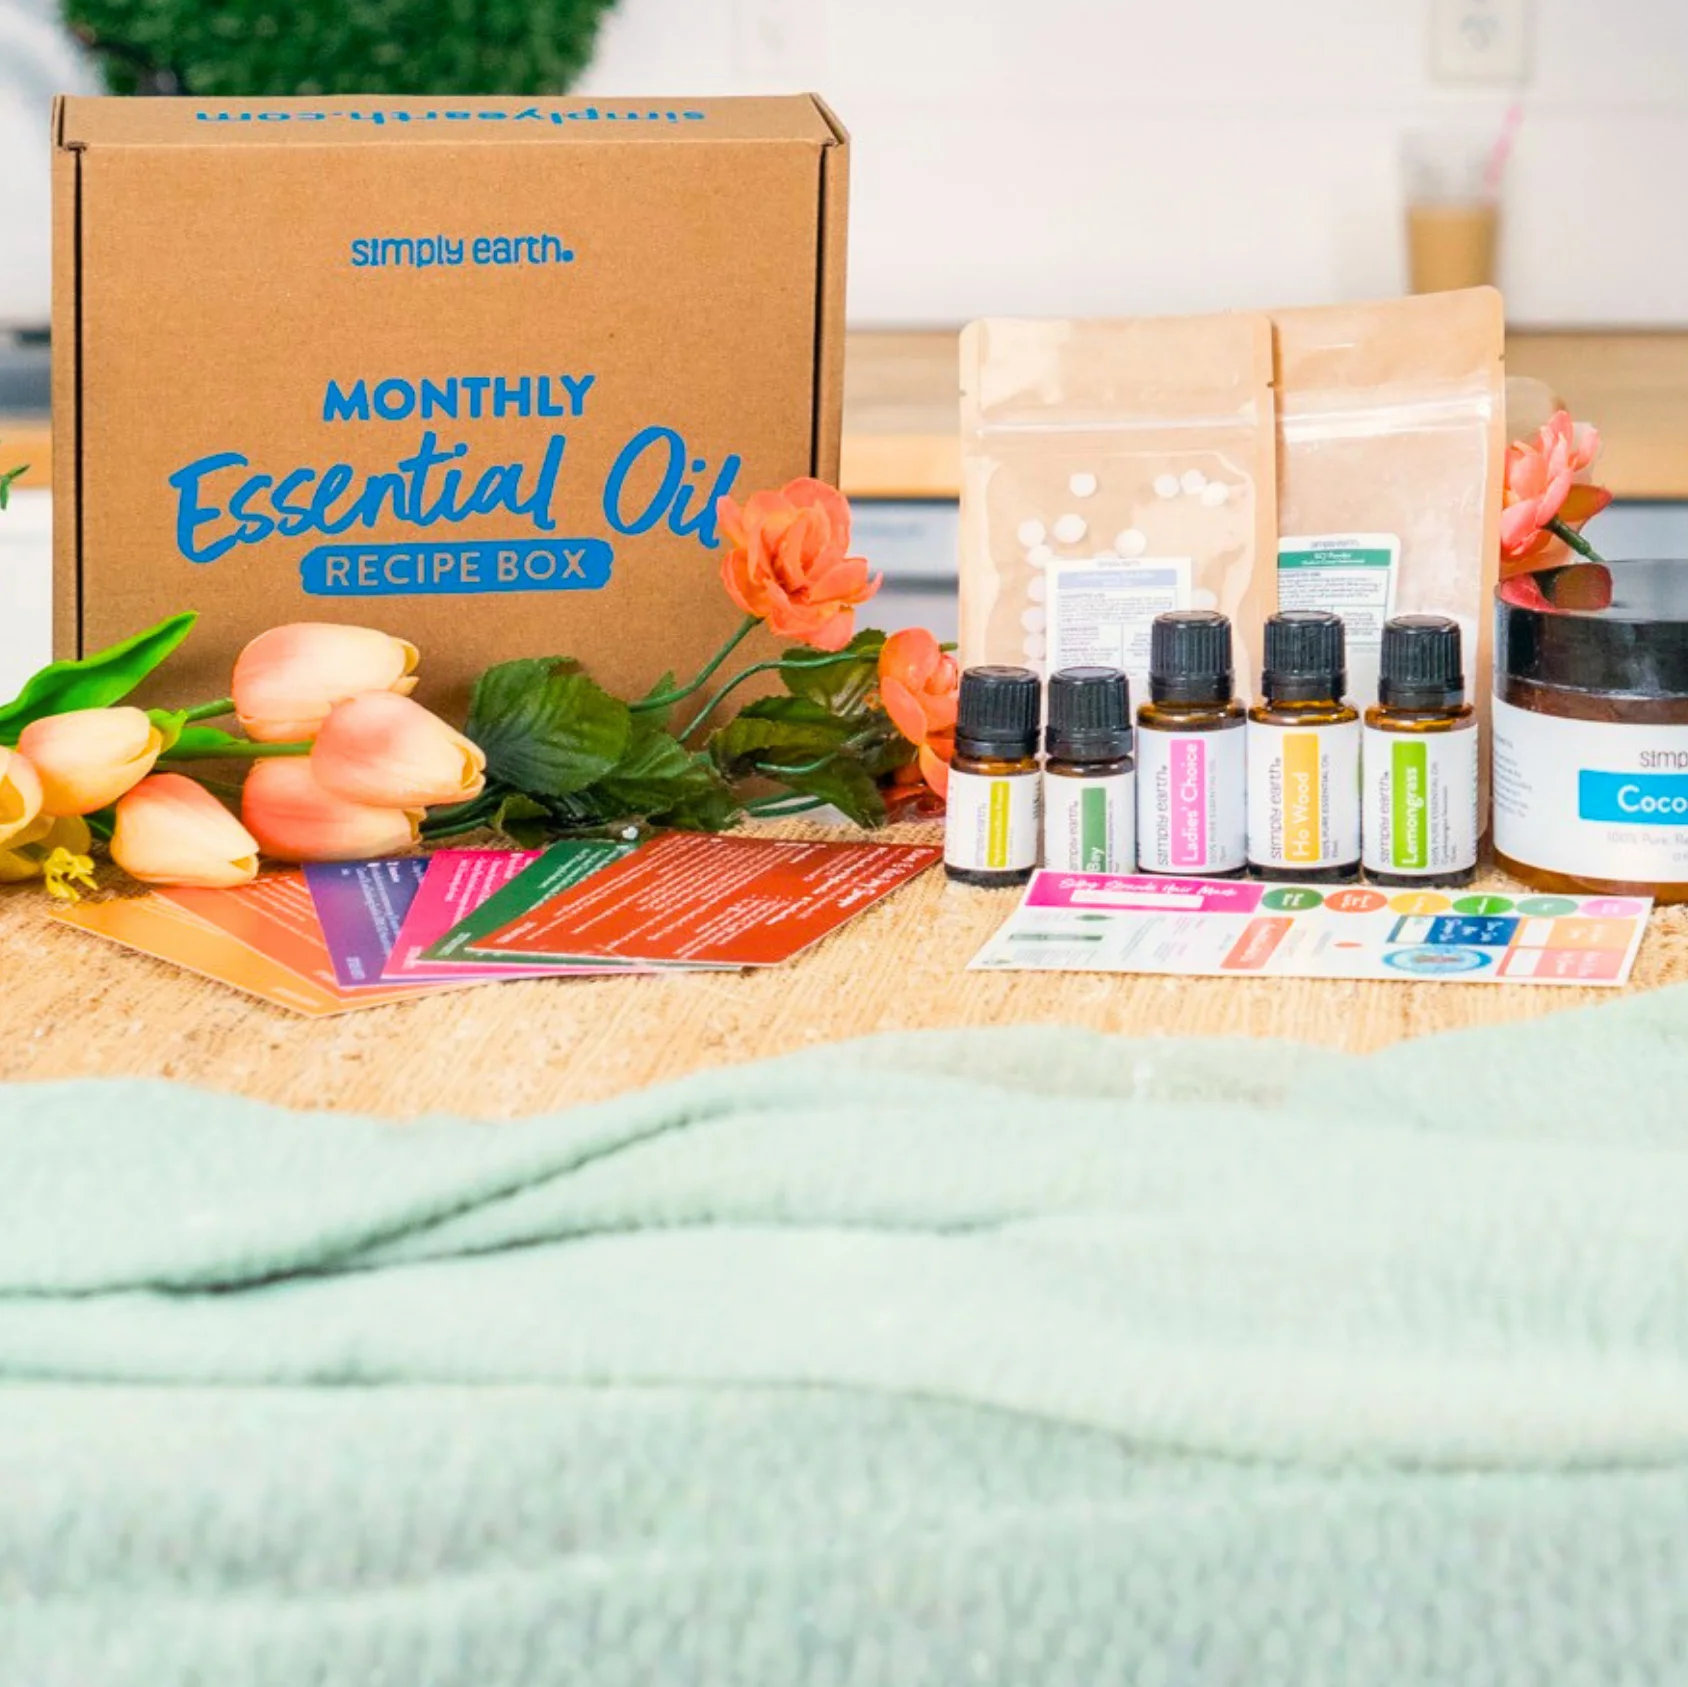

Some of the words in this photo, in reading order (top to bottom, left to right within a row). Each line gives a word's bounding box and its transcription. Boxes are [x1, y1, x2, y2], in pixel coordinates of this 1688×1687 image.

[196, 107, 705, 124] simplyearth.com
[350, 234, 464, 269] simply
[322, 374, 596, 422] MONTHLY
[168, 430, 567, 564] Essential
[602, 425, 742, 549] Oil
[325, 551, 482, 587] RECIPE
[497, 548, 588, 582] BOX
[1180, 743, 1199, 803] Choice
[1291, 771, 1311, 824] Wood
[1156, 814, 1168, 865] simply
[1179, 806, 1199, 862] Ladies'
[1269, 807, 1282, 860] simply
[1401, 766, 1424, 865] Lemongrass
[1085, 847, 1105, 872] Bay
[1291, 829, 1310, 857] Ho
